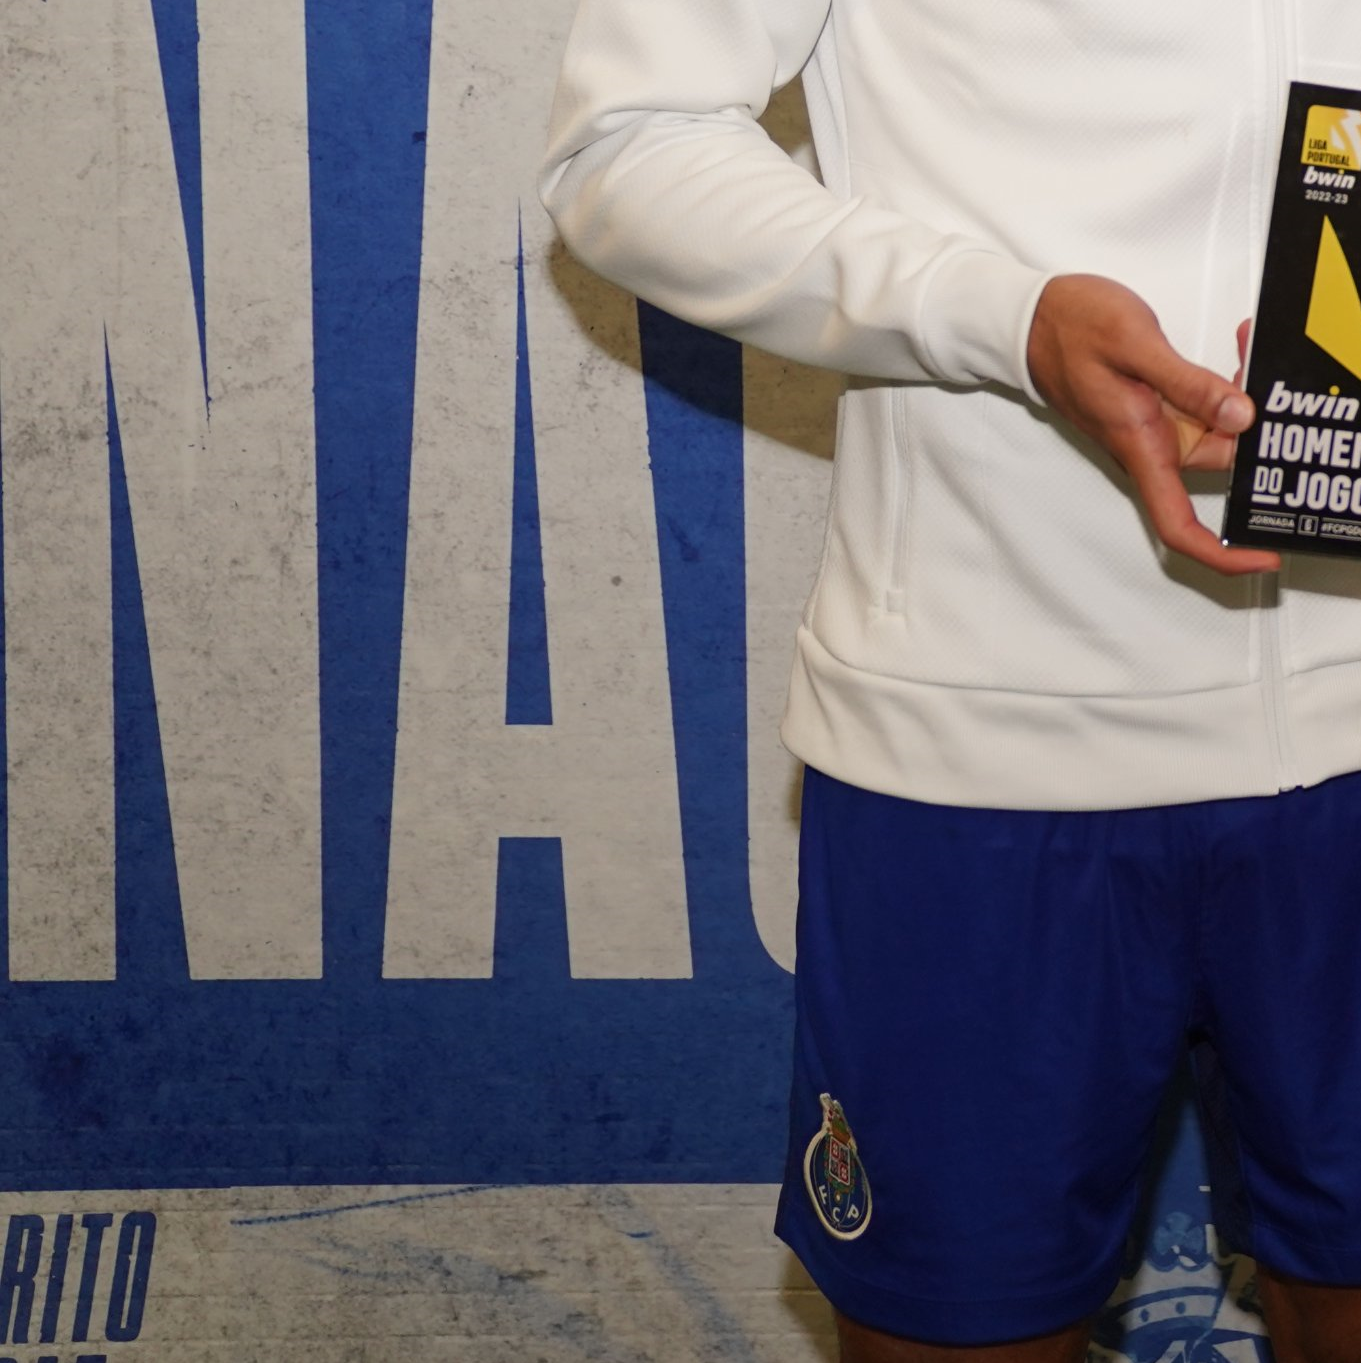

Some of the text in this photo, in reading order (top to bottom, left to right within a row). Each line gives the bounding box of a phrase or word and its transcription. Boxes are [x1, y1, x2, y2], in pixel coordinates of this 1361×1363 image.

[1308, 138, 1328, 150] LIGA
[1306, 150, 1350, 167] PORTUGAL
[1302, 165, 1356, 190] bwin
[1304, 189, 1349, 205] 2022-23
[1265, 381, 1360, 421] bwin
[1253, 465, 1284, 496] DO
[1249, 515, 1296, 528] JORNADA
[0, 1211, 157, 1344] RITO
